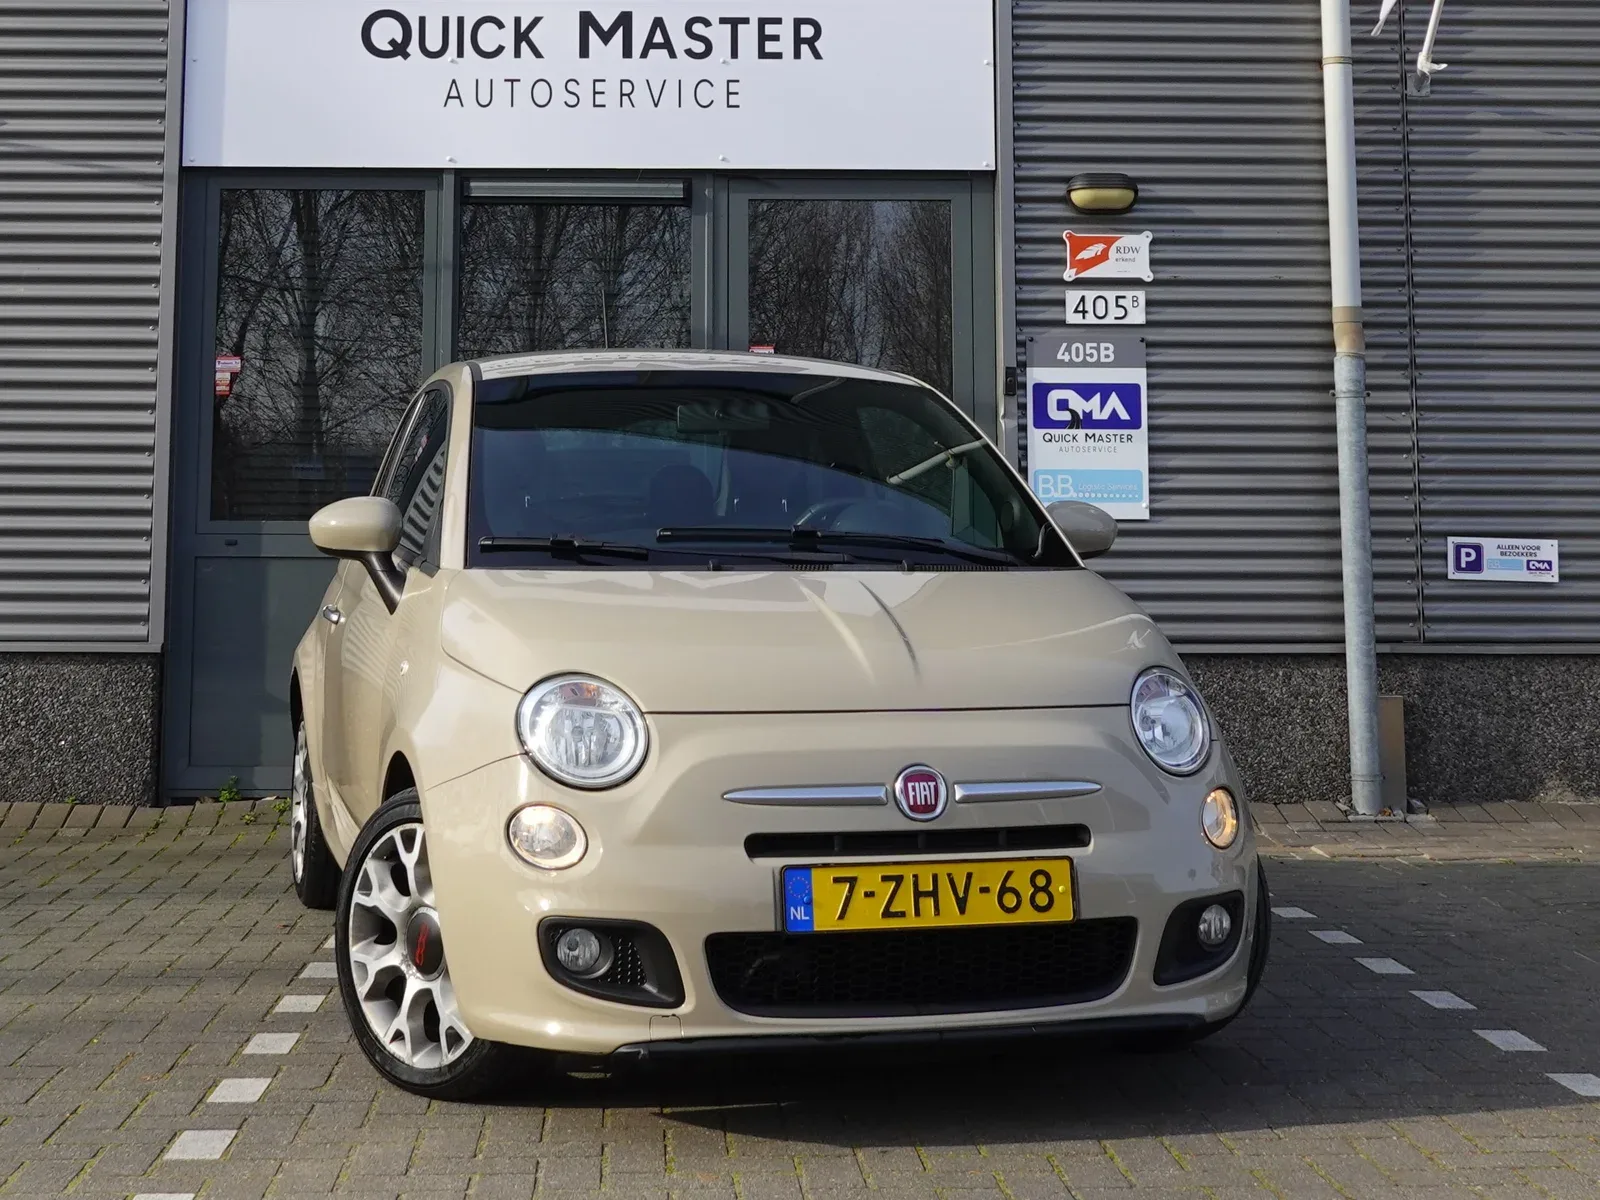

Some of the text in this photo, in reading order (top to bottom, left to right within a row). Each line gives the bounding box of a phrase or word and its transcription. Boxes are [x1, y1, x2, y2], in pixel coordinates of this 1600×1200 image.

[361, 9, 824, 60] QUICK MASTER
[443, 78, 741, 109] AUTOSERVICE
[1115, 246, 1140, 254] RDW
[1056, 342, 1115, 363] 405B
[1047, 389, 1131, 421] QMA
[1043, 432, 1133, 443] QUICK MASTER
[1460, 547, 1476, 568] P
[908, 781, 936, 806] FIAT
[832, 869, 1055, 920] 7-ZHV-68
[790, 906, 809, 921] NL
